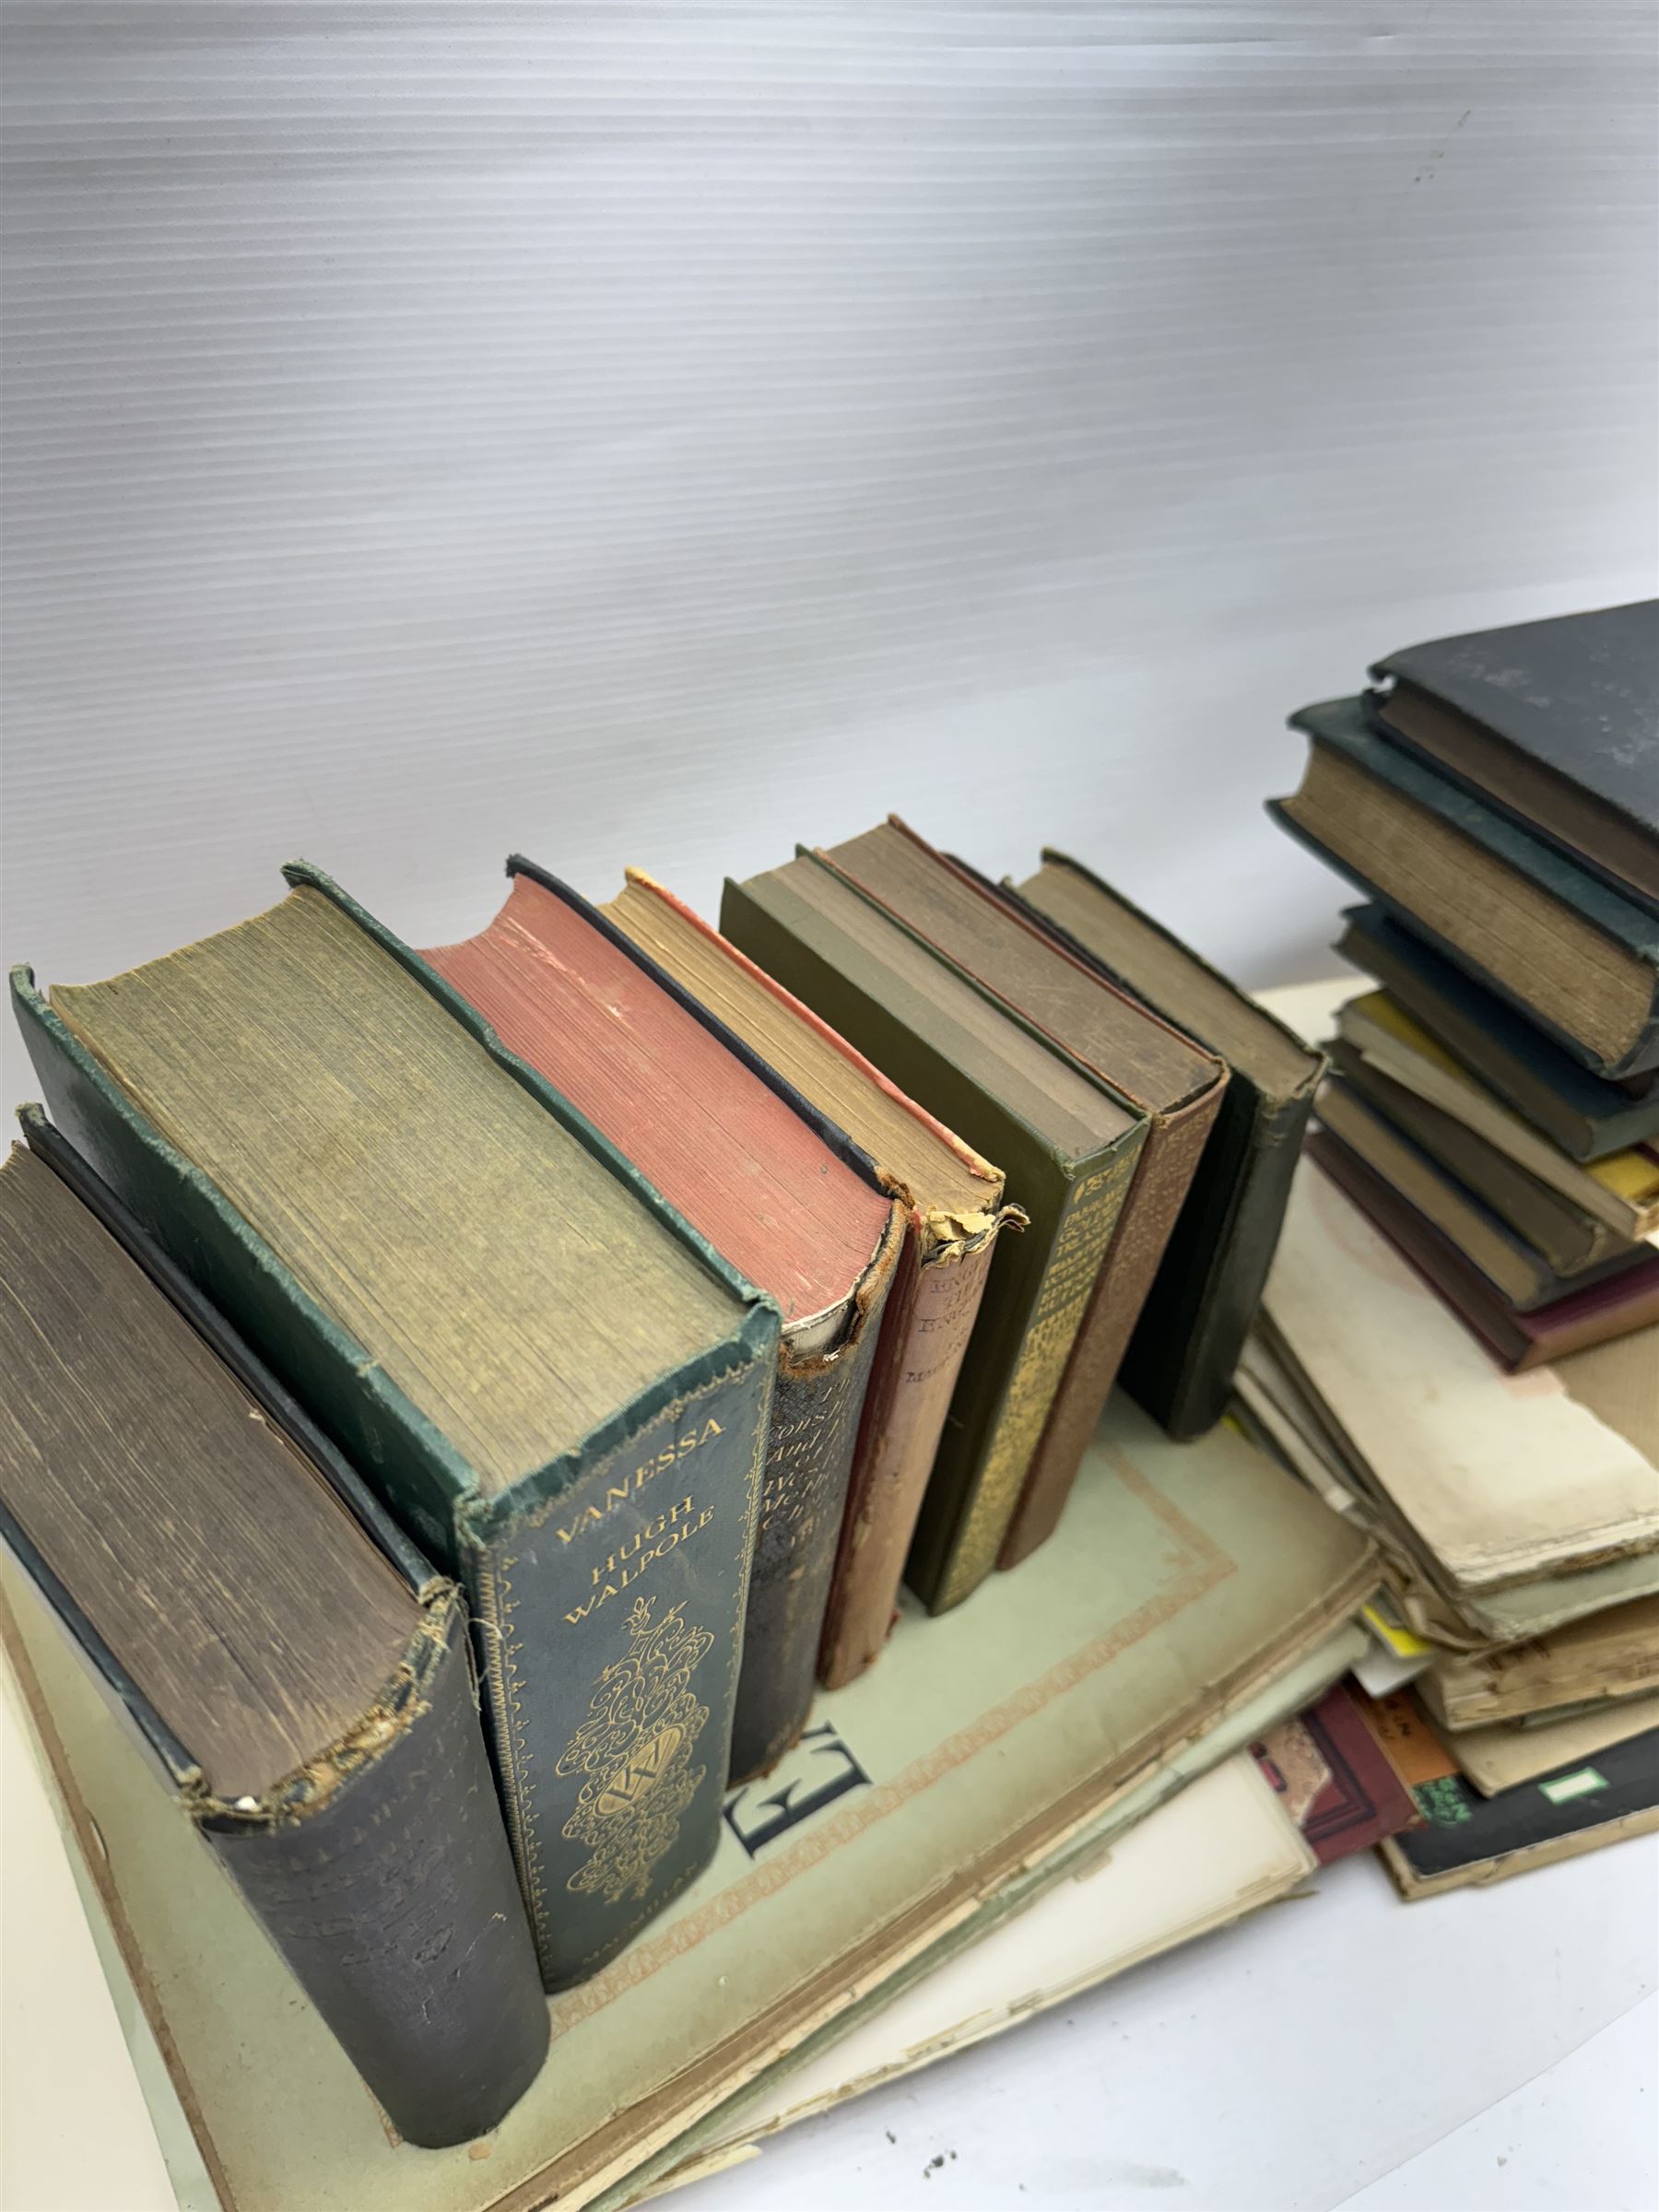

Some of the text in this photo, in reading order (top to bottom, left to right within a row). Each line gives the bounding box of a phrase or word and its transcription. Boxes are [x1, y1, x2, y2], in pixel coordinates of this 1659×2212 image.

[556, 1417, 727, 1545] VANESSA
[591, 1496, 695, 1587] HUGH
[561, 1505, 716, 1626] WALPOLE
